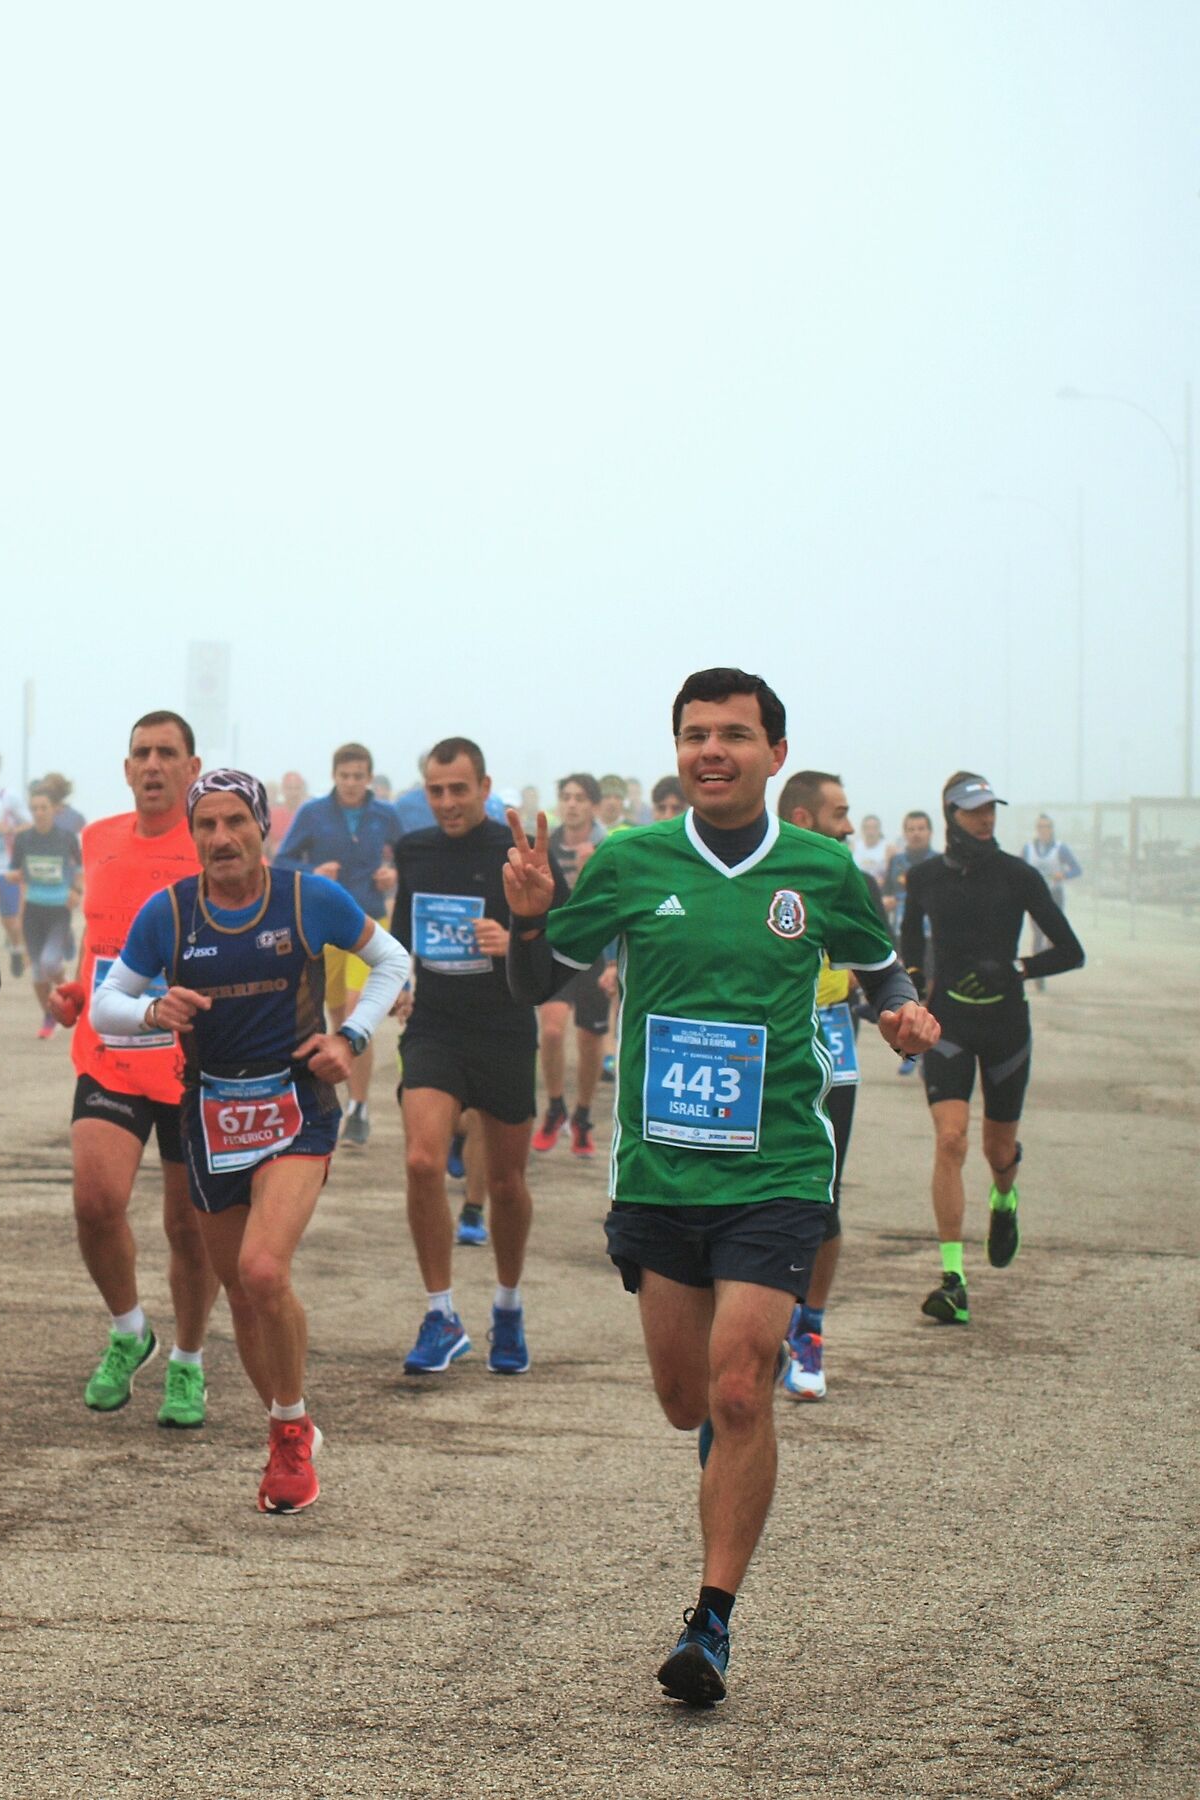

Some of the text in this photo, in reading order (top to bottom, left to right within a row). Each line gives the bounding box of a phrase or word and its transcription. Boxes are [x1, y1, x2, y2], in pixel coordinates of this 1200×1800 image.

[655, 908, 686, 917] adidas
[187, 946, 219, 959] asics
[661, 1061, 742, 1104] 443
[669, 1100, 711, 1118] ISRAEL
[217, 1102, 285, 1134] 672
[223, 1129, 273, 1145] FEDERICO
